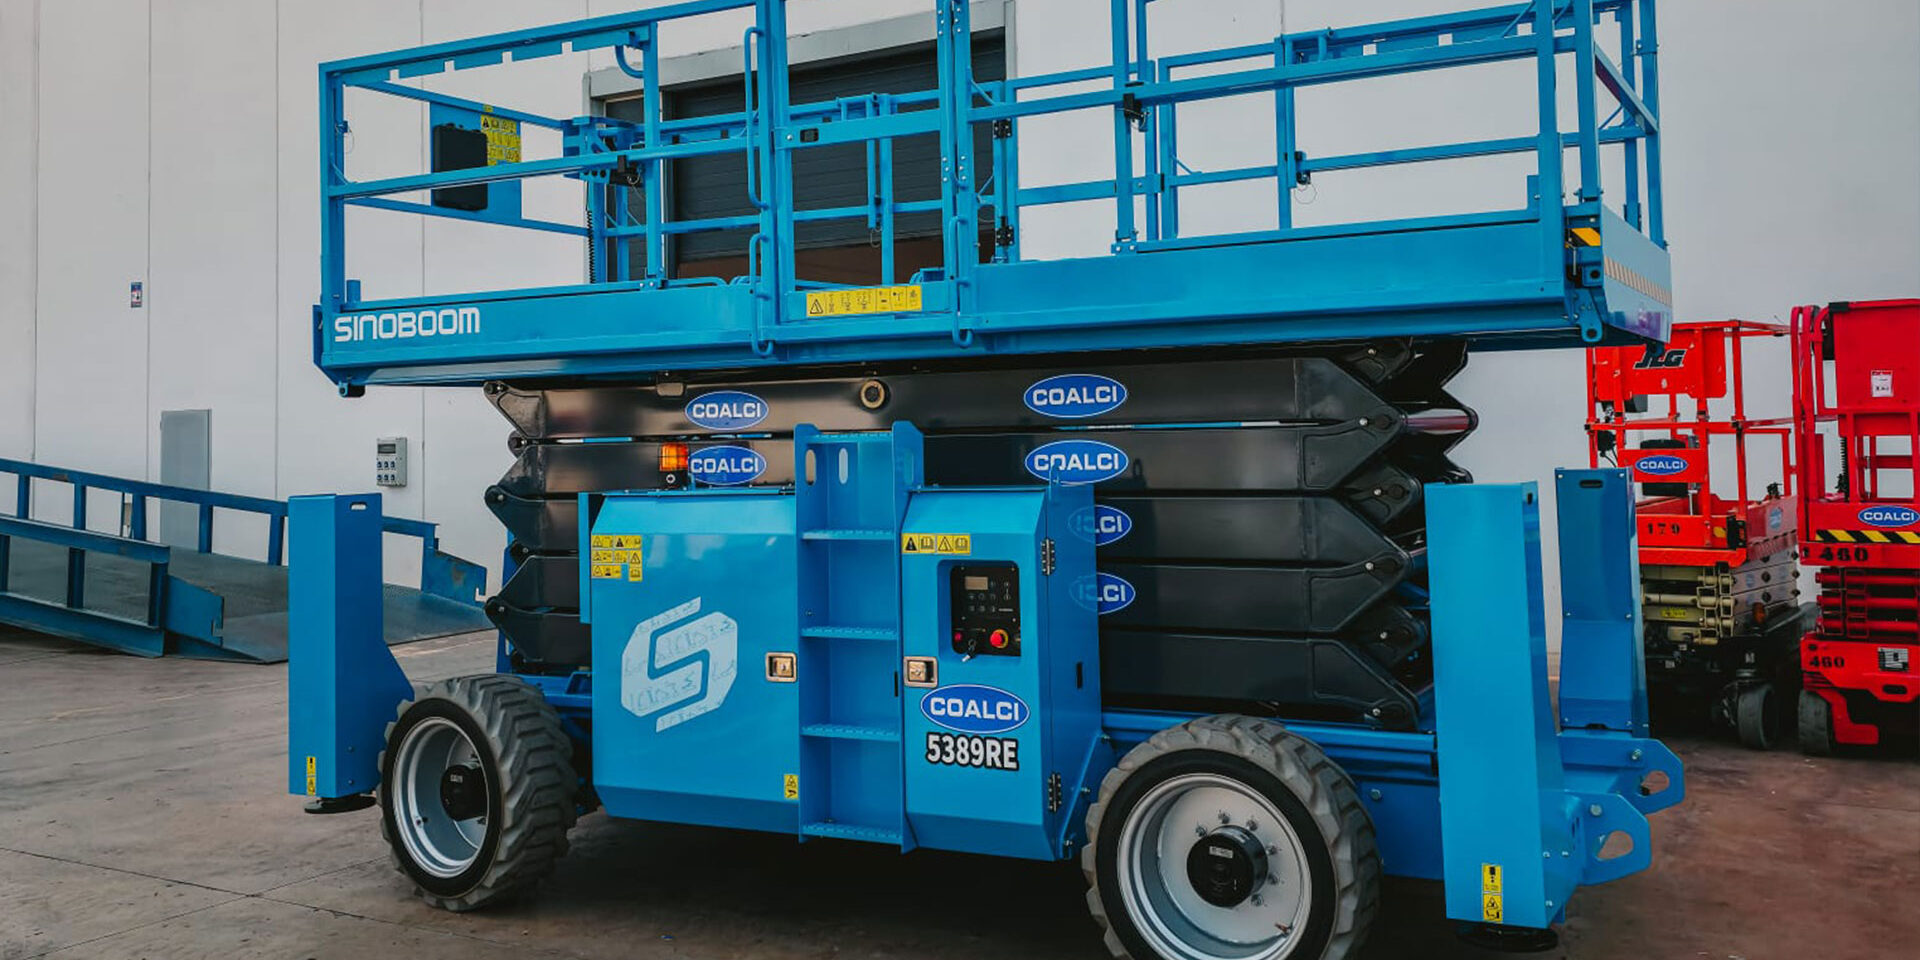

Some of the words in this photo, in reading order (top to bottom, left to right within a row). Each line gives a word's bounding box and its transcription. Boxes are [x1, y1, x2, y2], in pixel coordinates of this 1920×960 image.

[334, 307, 481, 343] SINOBOOM
[1032, 385, 1118, 406] COALCI
[692, 402, 762, 418] COALCI
[690, 457, 759, 473] COALCI
[1033, 453, 1120, 471] COALCI
[1640, 461, 1684, 469] COALCI
[1863, 511, 1915, 521] COALCI
[930, 697, 1020, 721] COALCI
[926, 732, 1019, 770] 5389RE
